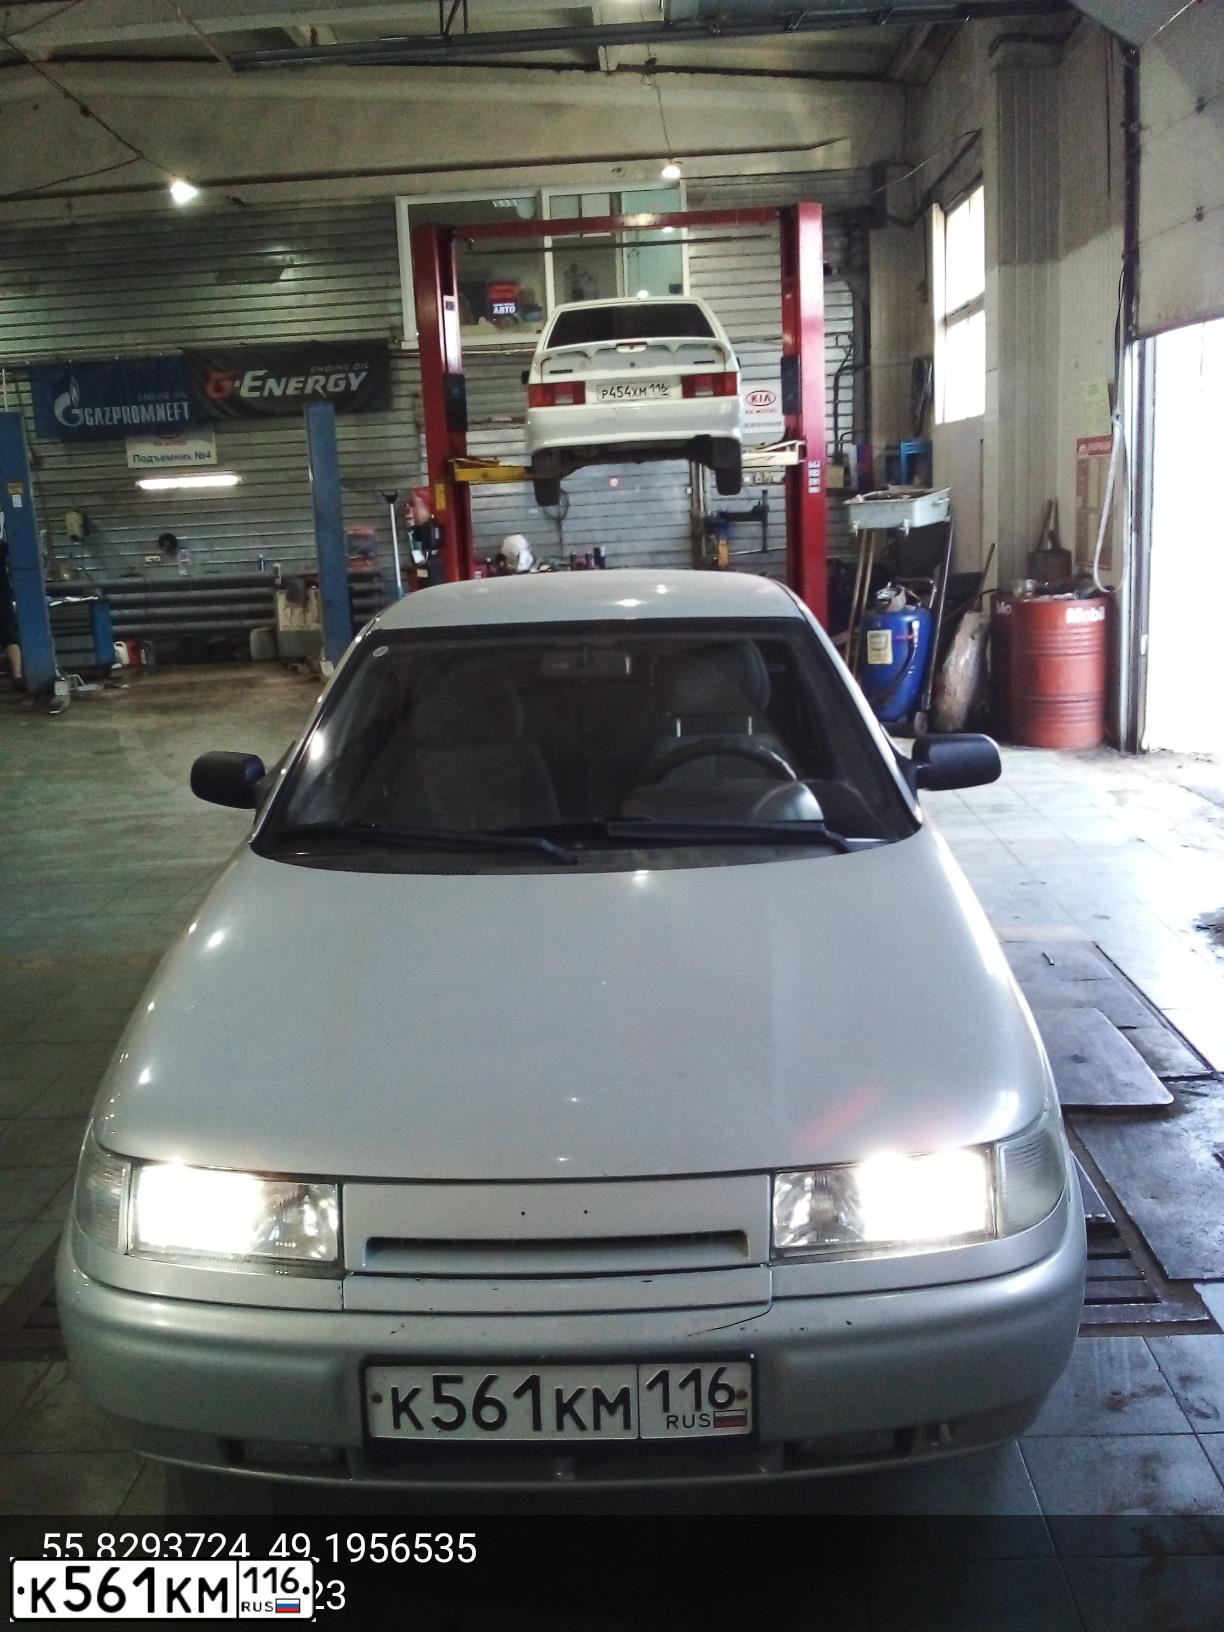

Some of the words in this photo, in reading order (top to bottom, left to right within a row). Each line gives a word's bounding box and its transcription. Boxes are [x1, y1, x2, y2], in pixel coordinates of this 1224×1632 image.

[751, 394, 771, 403] KIA
[85, 402, 190, 425] GAZPROMNEFT
[1066, 605, 1105, 625] Mobil
[645, 1366, 736, 1413] 116
[666, 1414, 712, 1430] RUS
